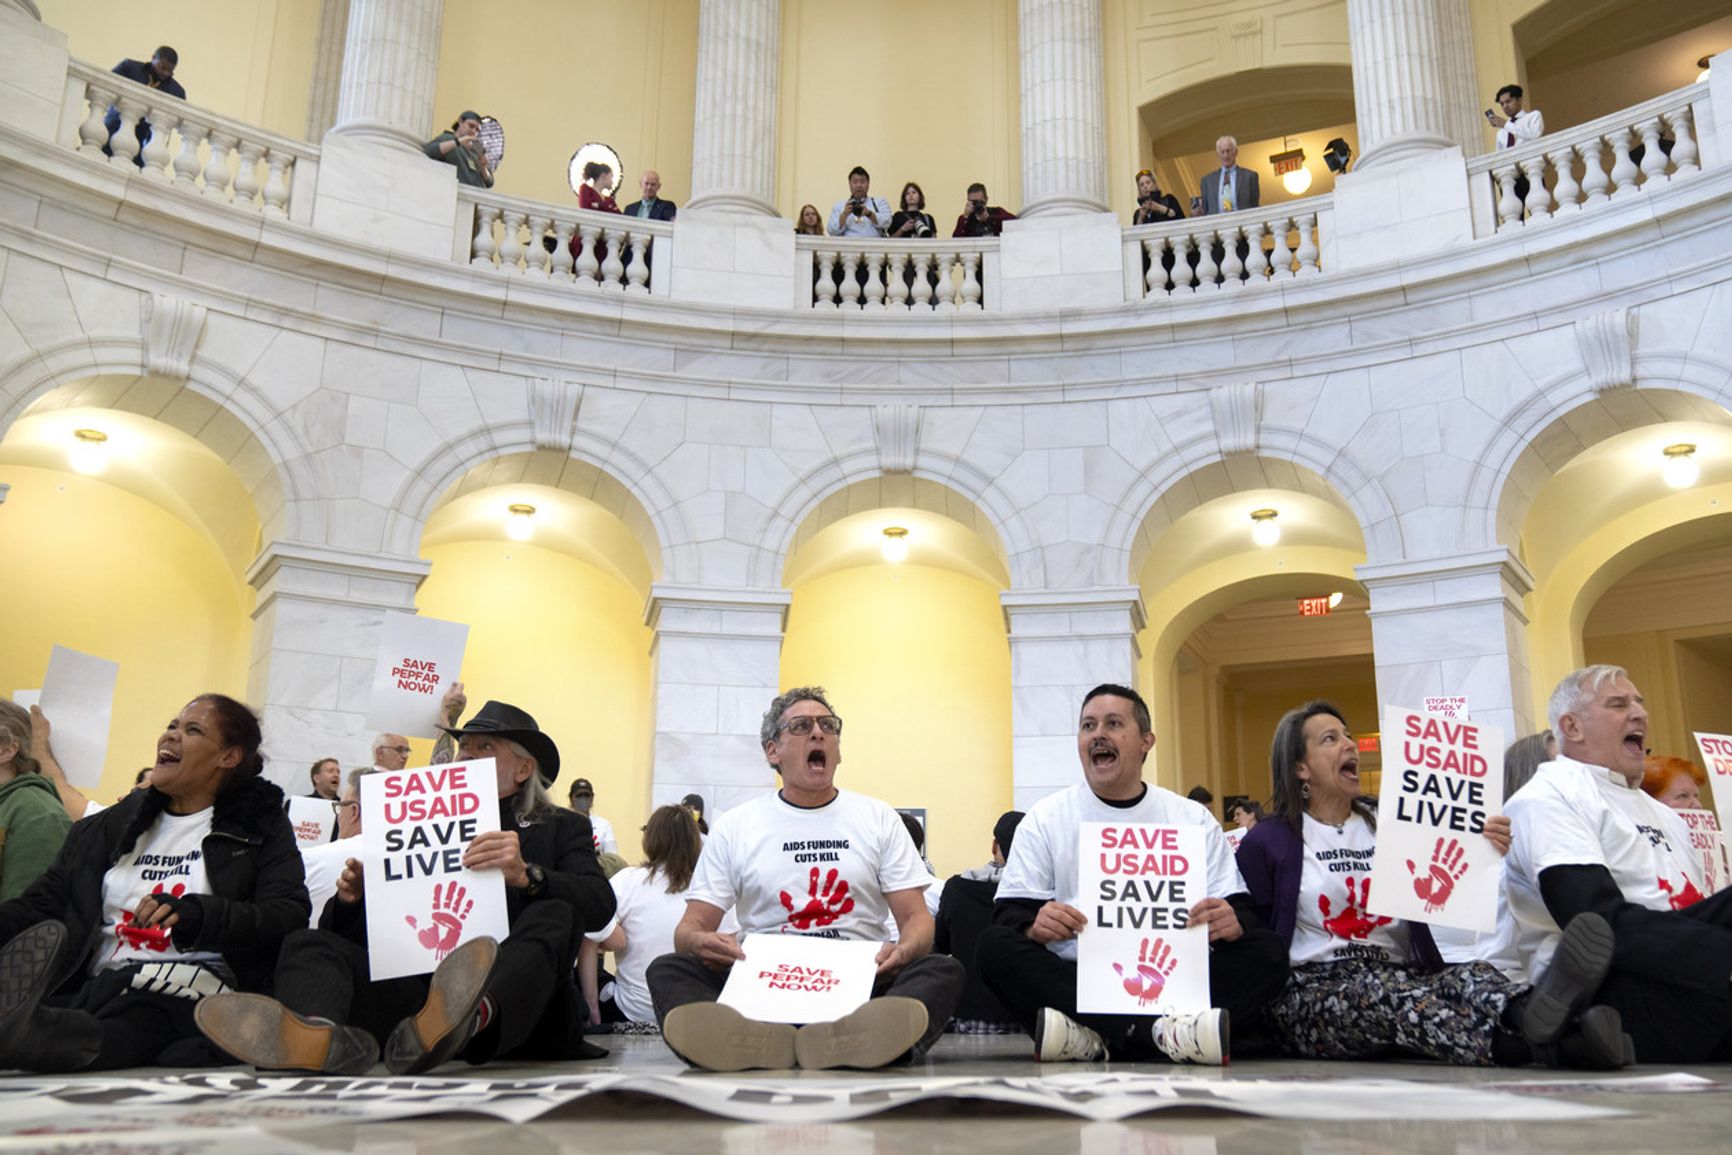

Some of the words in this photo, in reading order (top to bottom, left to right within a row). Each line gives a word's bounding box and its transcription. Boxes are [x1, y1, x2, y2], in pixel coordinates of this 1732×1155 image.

[1303, 598, 1328, 616] EXIT
[402, 657, 437, 673] SAVE
[391, 666, 440, 685] PEPFAR
[397, 679, 434, 695] NOW!
[1428, 703, 1463, 711] DEADLY
[1450, 696, 1466, 704] THE
[1405, 714, 1479, 750] SAVE
[1403, 740, 1488, 778] USAID
[384, 766, 468, 799] SAVE
[1401, 769, 1485, 806] SAVE
[383, 791, 480, 825] USAID
[1396, 795, 1487, 834] LIVES
[384, 818, 478, 852] SAVE
[1101, 827, 1179, 851] SAVE
[1689, 832, 1715, 850] EADLY
[782, 841, 806, 852] AIDS
[807, 839, 850, 850] FUNDING
[133, 854, 161, 867] AIDS
[161, 849, 202, 867] FUNIN
[794, 853, 818, 863] CUTS
[819, 852, 840, 862] KILL
[1315, 849, 1339, 861] AIDS
[383, 848, 463, 882] LIVE
[1100, 852, 1190, 877] USAID
[1328, 861, 1352, 873] CUTS
[1352, 860, 1372, 872] KILL
[1099, 878, 1187, 903] SAVE
[1097, 904, 1190, 930] LIVES
[758, 971, 841, 985] PEPFAR
[777, 963, 833, 978] SAVE
[768, 981, 832, 993] NOW!
